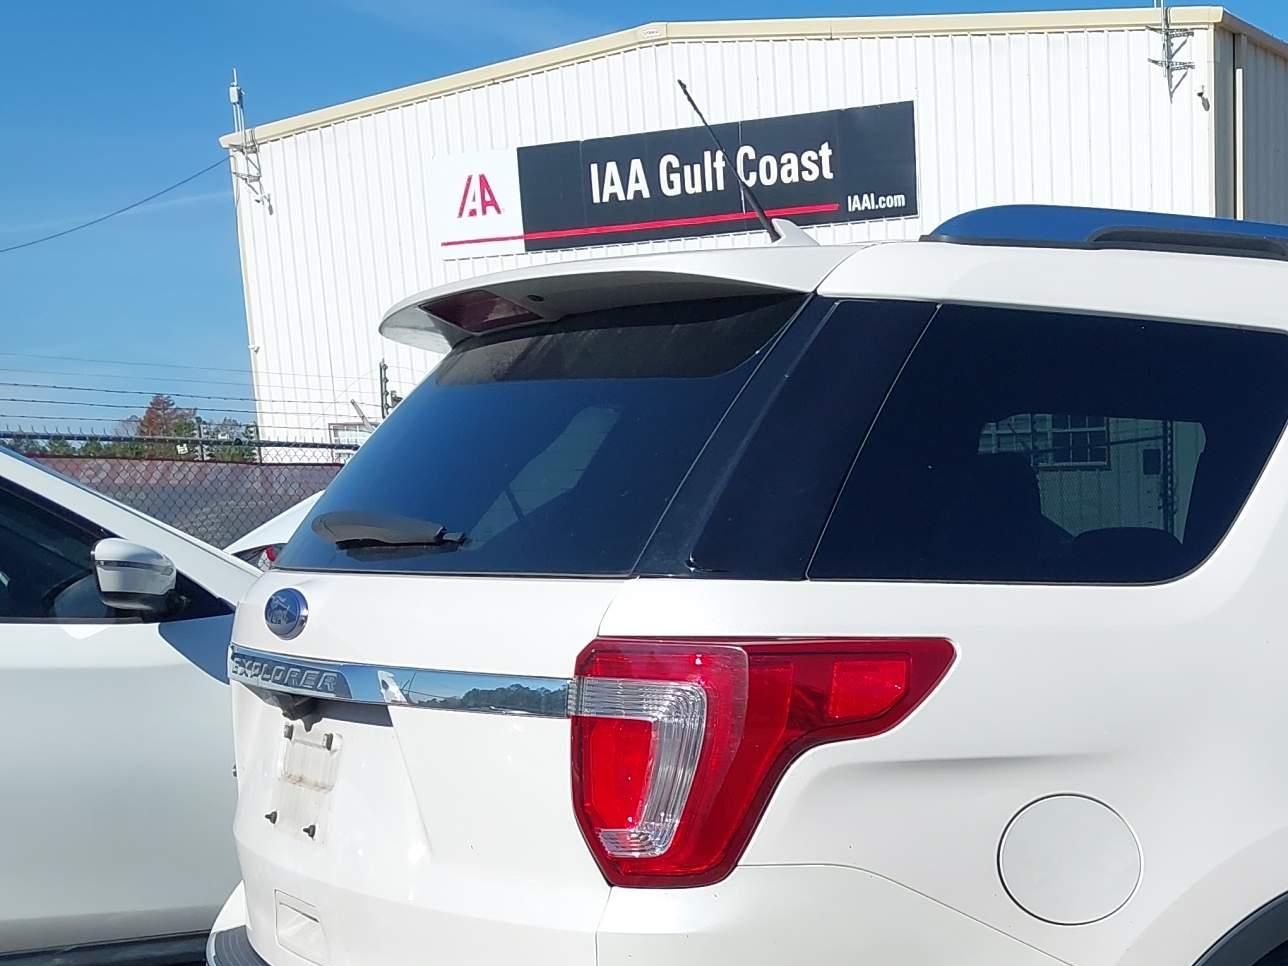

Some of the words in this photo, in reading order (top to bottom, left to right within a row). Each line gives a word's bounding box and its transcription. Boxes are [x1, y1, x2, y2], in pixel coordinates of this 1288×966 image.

[590, 157, 651, 204] IAA
[659, 146, 727, 197] Gulf
[736, 141, 834, 187] Coast
[847, 192, 907, 213] IAAI.com
[231, 657, 337, 692] EXPLORER
